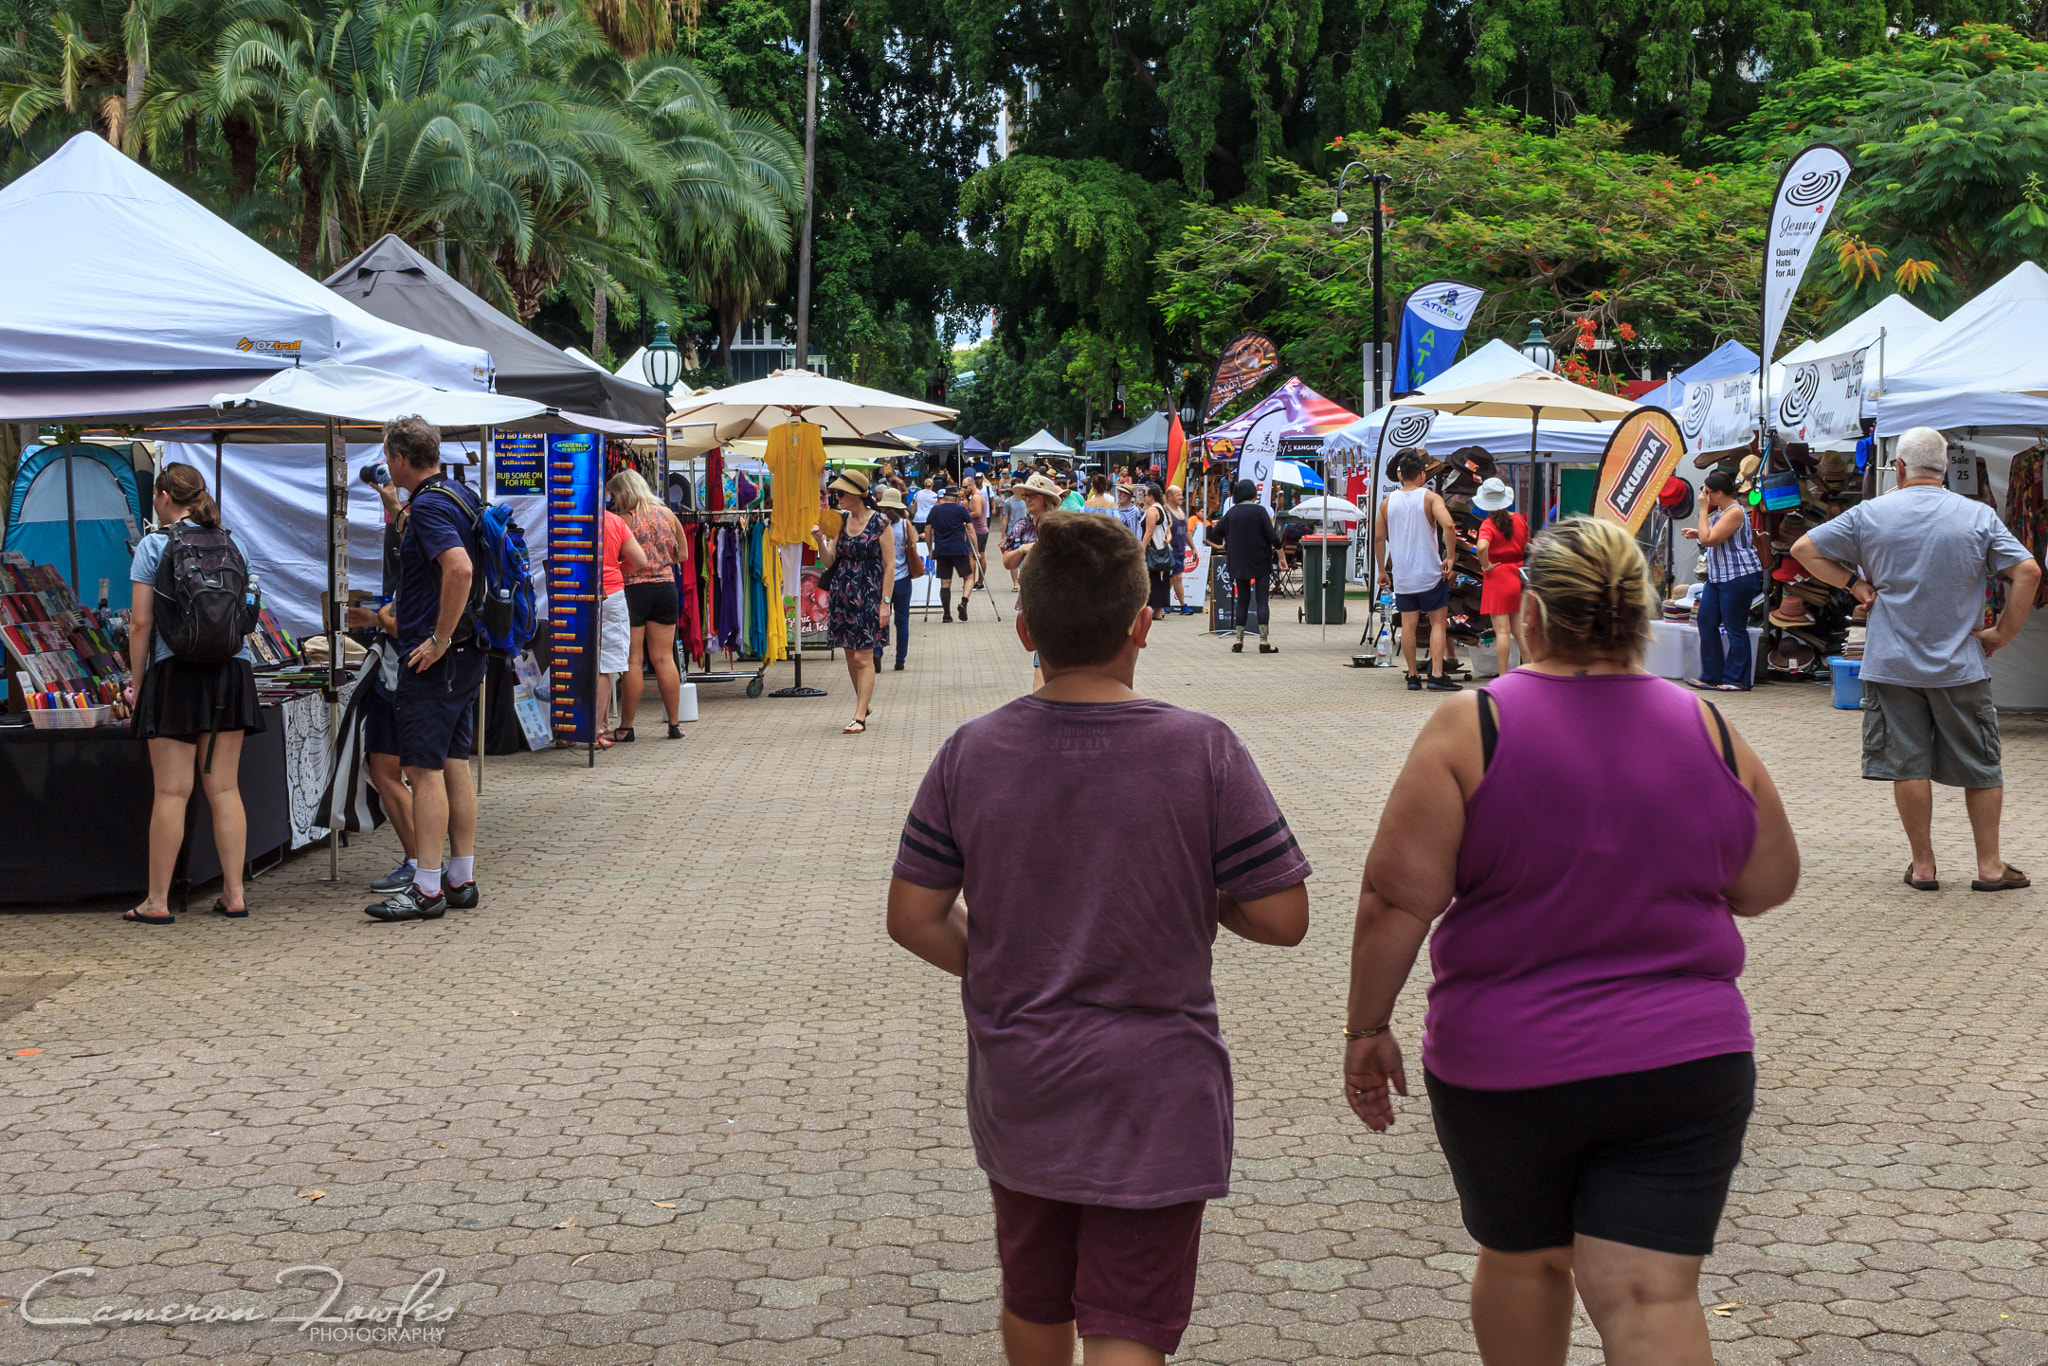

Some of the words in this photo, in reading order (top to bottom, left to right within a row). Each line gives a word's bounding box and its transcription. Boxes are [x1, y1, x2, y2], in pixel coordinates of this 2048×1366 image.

[1780, 215, 1817, 238] Jenny
[1776, 248, 1800, 257] Quality
[1776, 259, 1791, 267] Hats
[1776, 269, 1785, 277] for
[1786, 268, 1796, 277] All
[1422, 300, 1464, 321] ATM2U
[256, 341, 301, 350] OZtrail
[1831, 360, 1851, 382] Quality
[1217, 371, 1247, 397] Andy's
[1208, 391, 1237, 416] KANGAROO
[1276, 441, 1292, 456] dy's
[507, 451, 545, 459] Magnesium
[1951, 456, 1970, 465] Sale
[496, 472, 510, 480] RUB
[511, 472, 530, 480] SOME
[1616, 438, 1661, 510] AKUBRA
[1957, 470, 1969, 480] 25
[505, 479, 519, 487] FOR
[520, 479, 537, 487] FREE
